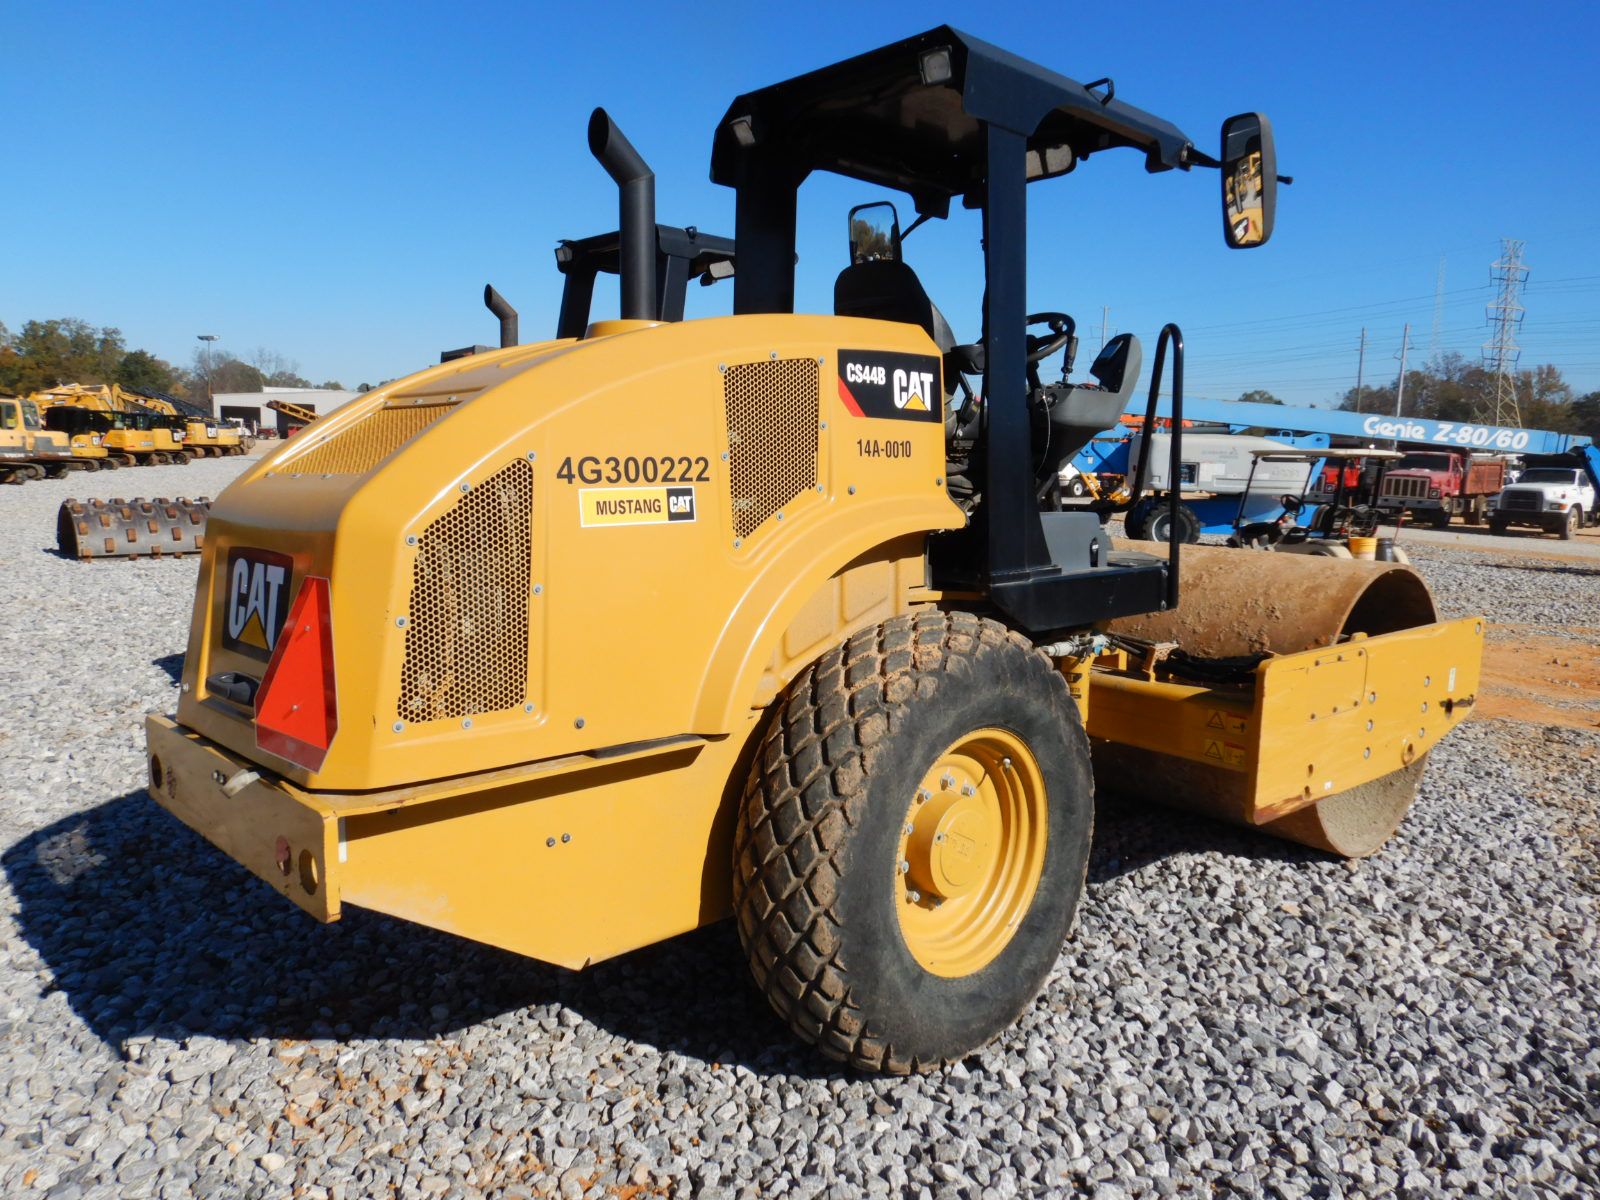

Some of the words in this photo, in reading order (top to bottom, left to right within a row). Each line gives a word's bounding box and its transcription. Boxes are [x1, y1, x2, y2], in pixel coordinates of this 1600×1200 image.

[846, 362, 886, 385] CS44B
[893, 368, 934, 411] CAT
[1363, 416, 1425, 440] Genie
[1432, 423, 1529, 449] Z-80/60
[857, 439, 912, 458] 14A-0010
[556, 456, 711, 485] 4G300222
[596, 498, 662, 515] MUSTANG
[669, 496, 692, 513] CAT
[228, 557, 286, 651] CAT
